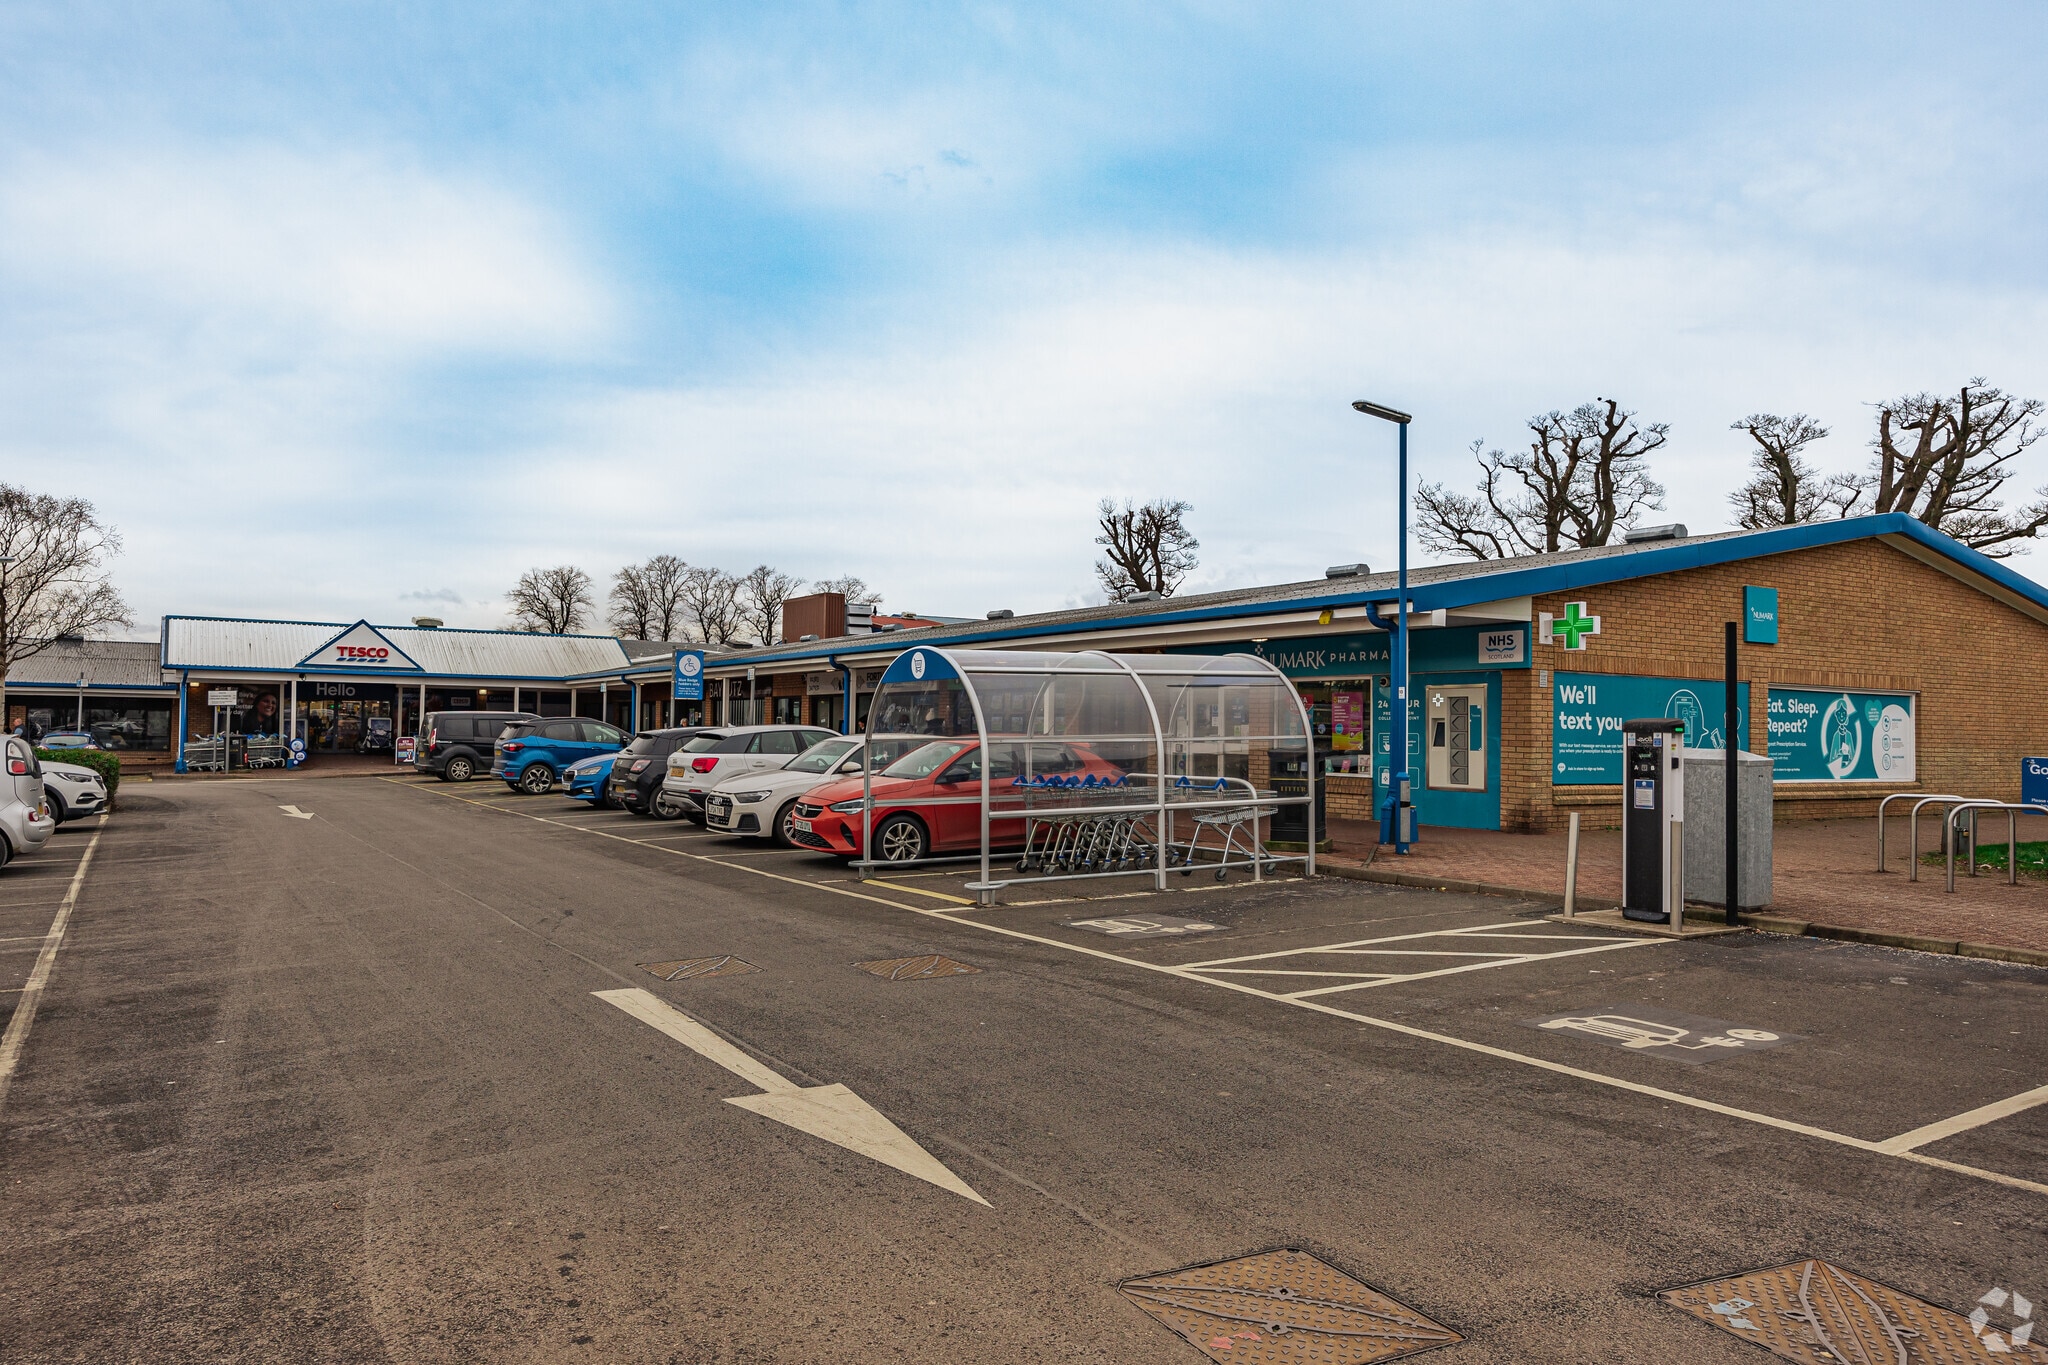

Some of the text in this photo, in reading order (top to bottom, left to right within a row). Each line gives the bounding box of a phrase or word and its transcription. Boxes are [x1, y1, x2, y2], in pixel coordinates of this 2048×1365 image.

[1753, 611, 1774, 620] NUMARK
[1488, 634, 1514, 646] NHS
[336, 646, 388, 658] TESCO
[1262, 650, 1389, 670] NUMARK PHARMA
[316, 683, 356, 696] Hello
[710, 681, 723, 697] BAY
[729, 681, 742, 696] UTZ
[1560, 685, 1596, 704] We'll
[1788, 698, 1818, 718] Sleep.
[1559, 711, 1622, 736] text you
[1768, 718, 1807, 736] Repeat?
